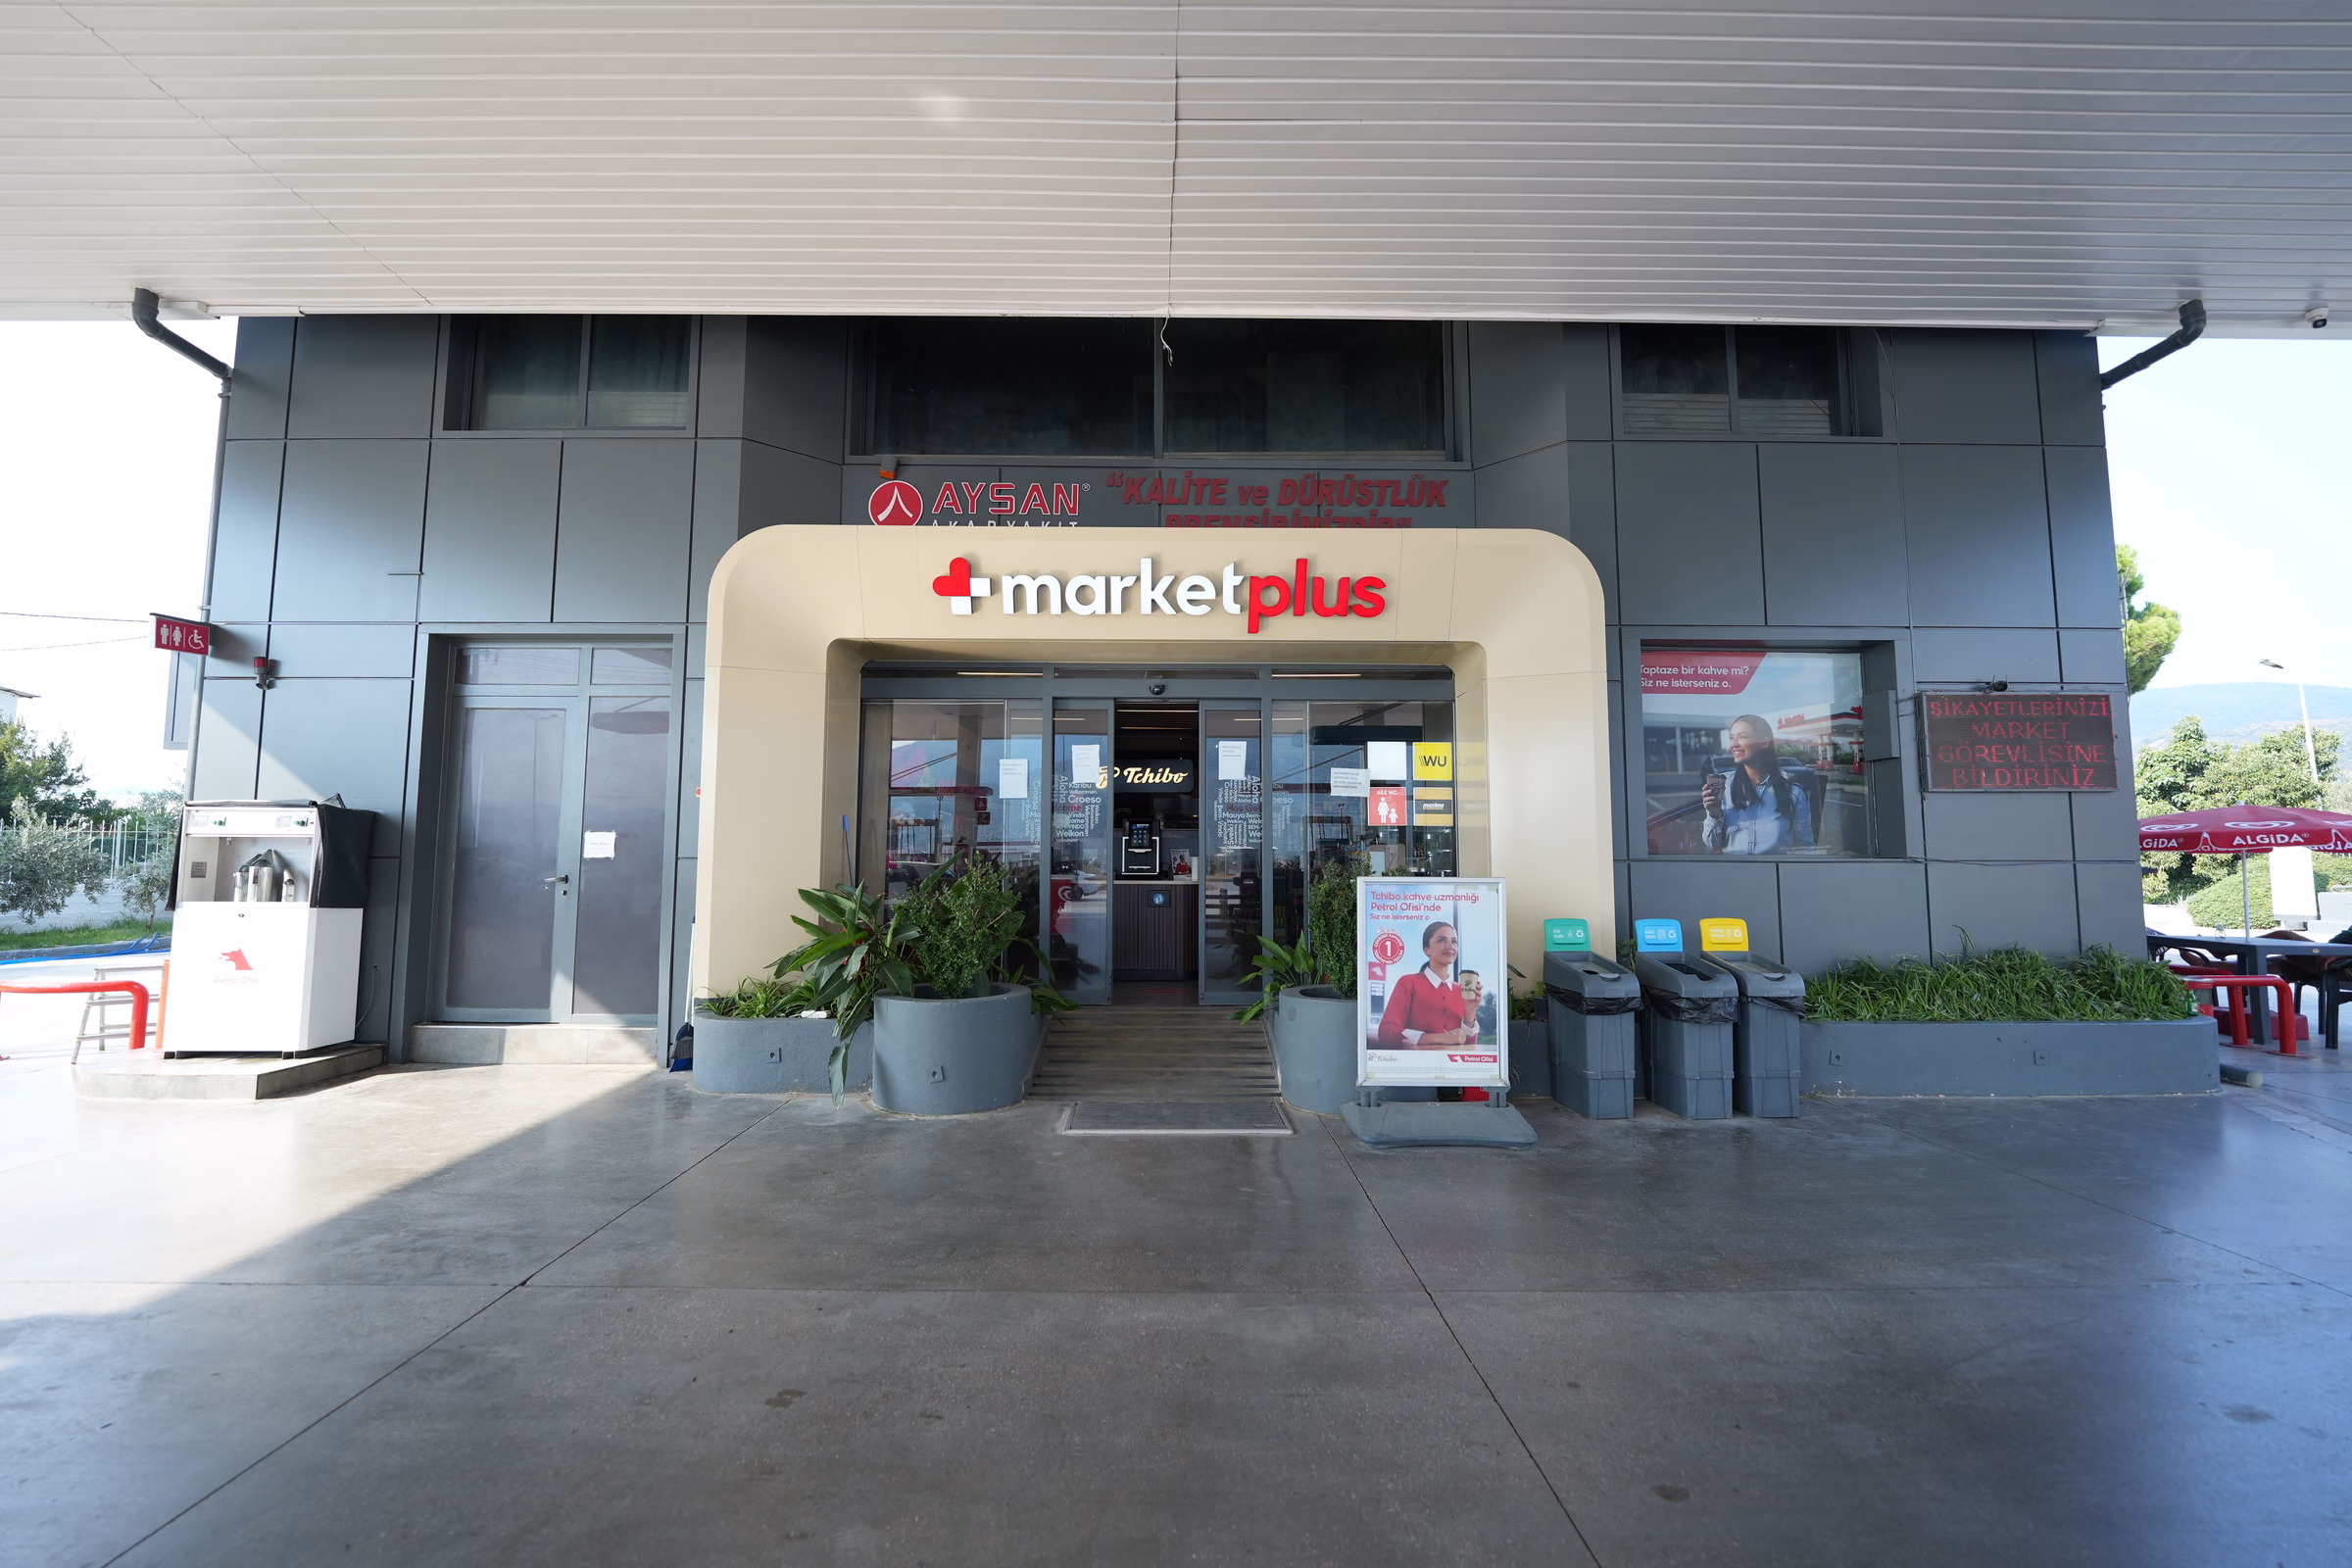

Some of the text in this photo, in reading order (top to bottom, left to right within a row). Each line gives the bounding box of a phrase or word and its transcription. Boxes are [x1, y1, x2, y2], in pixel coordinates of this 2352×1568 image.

[1238, 485, 1269, 506] ve
[1278, 473, 1448, 507] DÜRÜSTLÜK
[1002, 557, 1387, 634] marketplus
[1682, 665, 1695, 675] bir
[1698, 665, 1729, 675] kahve
[1732, 665, 1749, 675] mi?
[1672, 678, 1719, 688] isterseniz
[1971, 721, 2071, 740] MARKET
[1937, 741, 2107, 763] GÖREVLİSİNE
[1123, 766, 1189, 784] Tchibo
[1952, 763, 2095, 787] BİLDİRİNİZ
[1371, 891, 1480, 904] Tchibo kahve uzmanlığı
[1371, 902, 1397, 911] Petrol
[1385, 941, 1392, 956] 1
